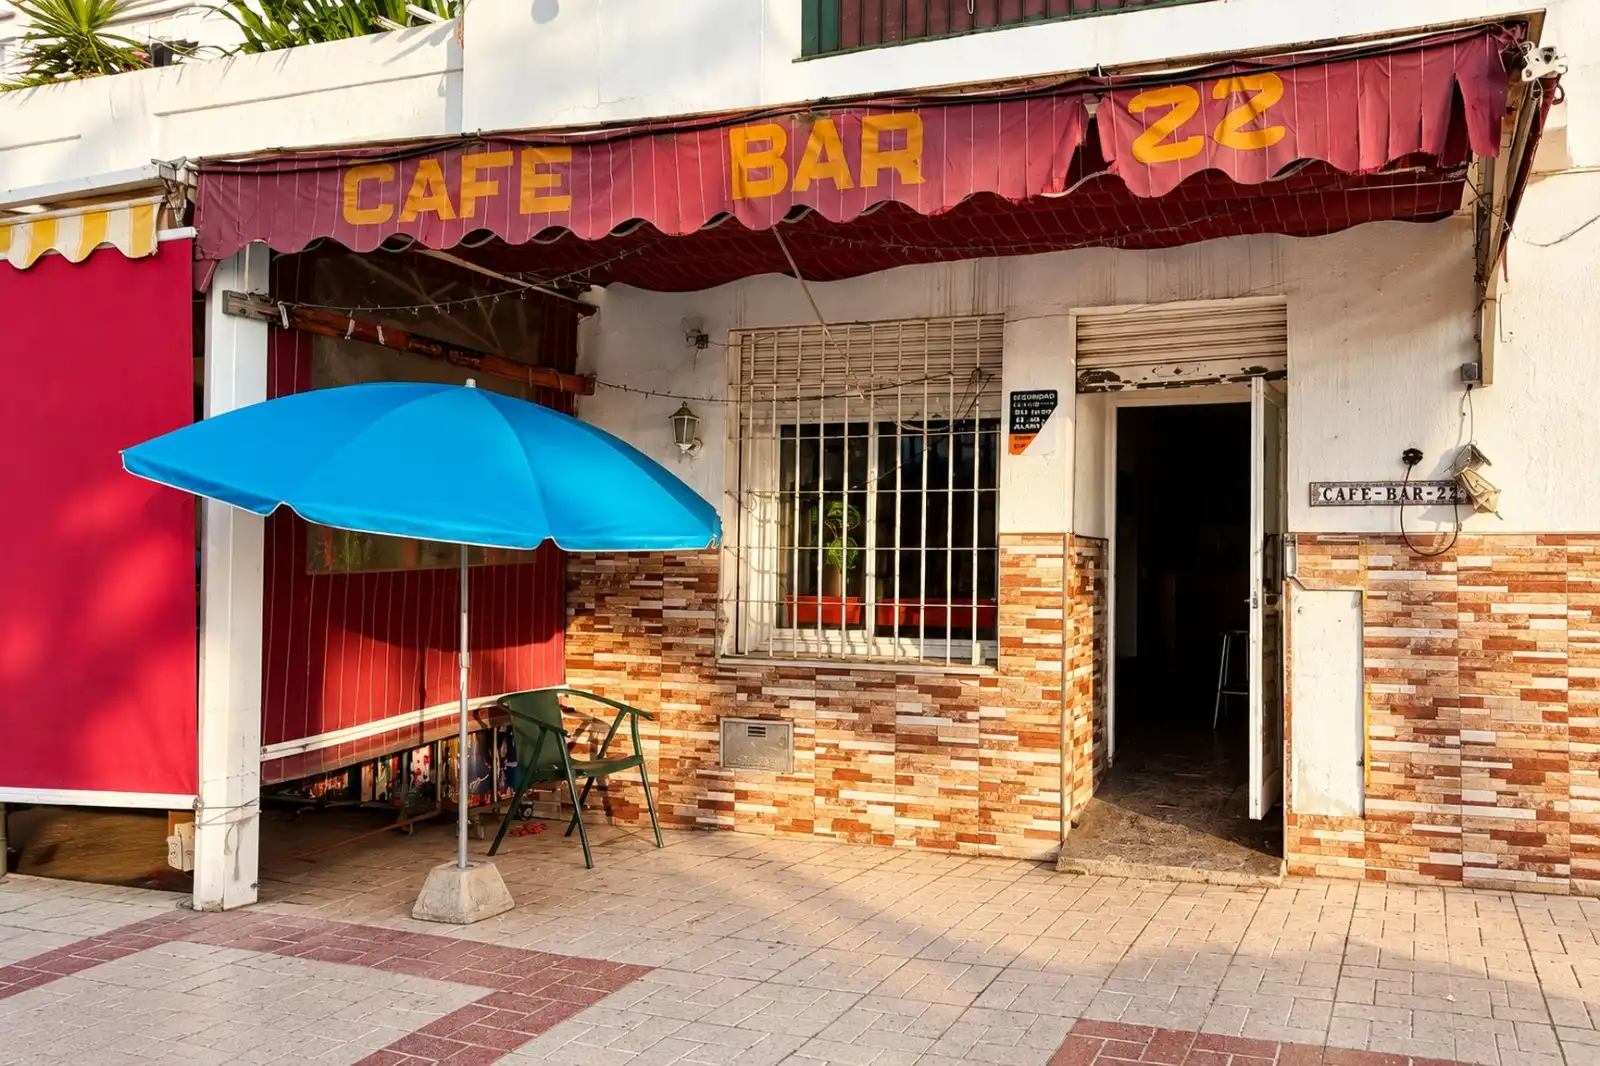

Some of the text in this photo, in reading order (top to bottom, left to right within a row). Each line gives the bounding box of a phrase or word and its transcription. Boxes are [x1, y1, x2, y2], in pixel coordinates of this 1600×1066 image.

[343, 72, 1286, 225] CAFE BAR 22
